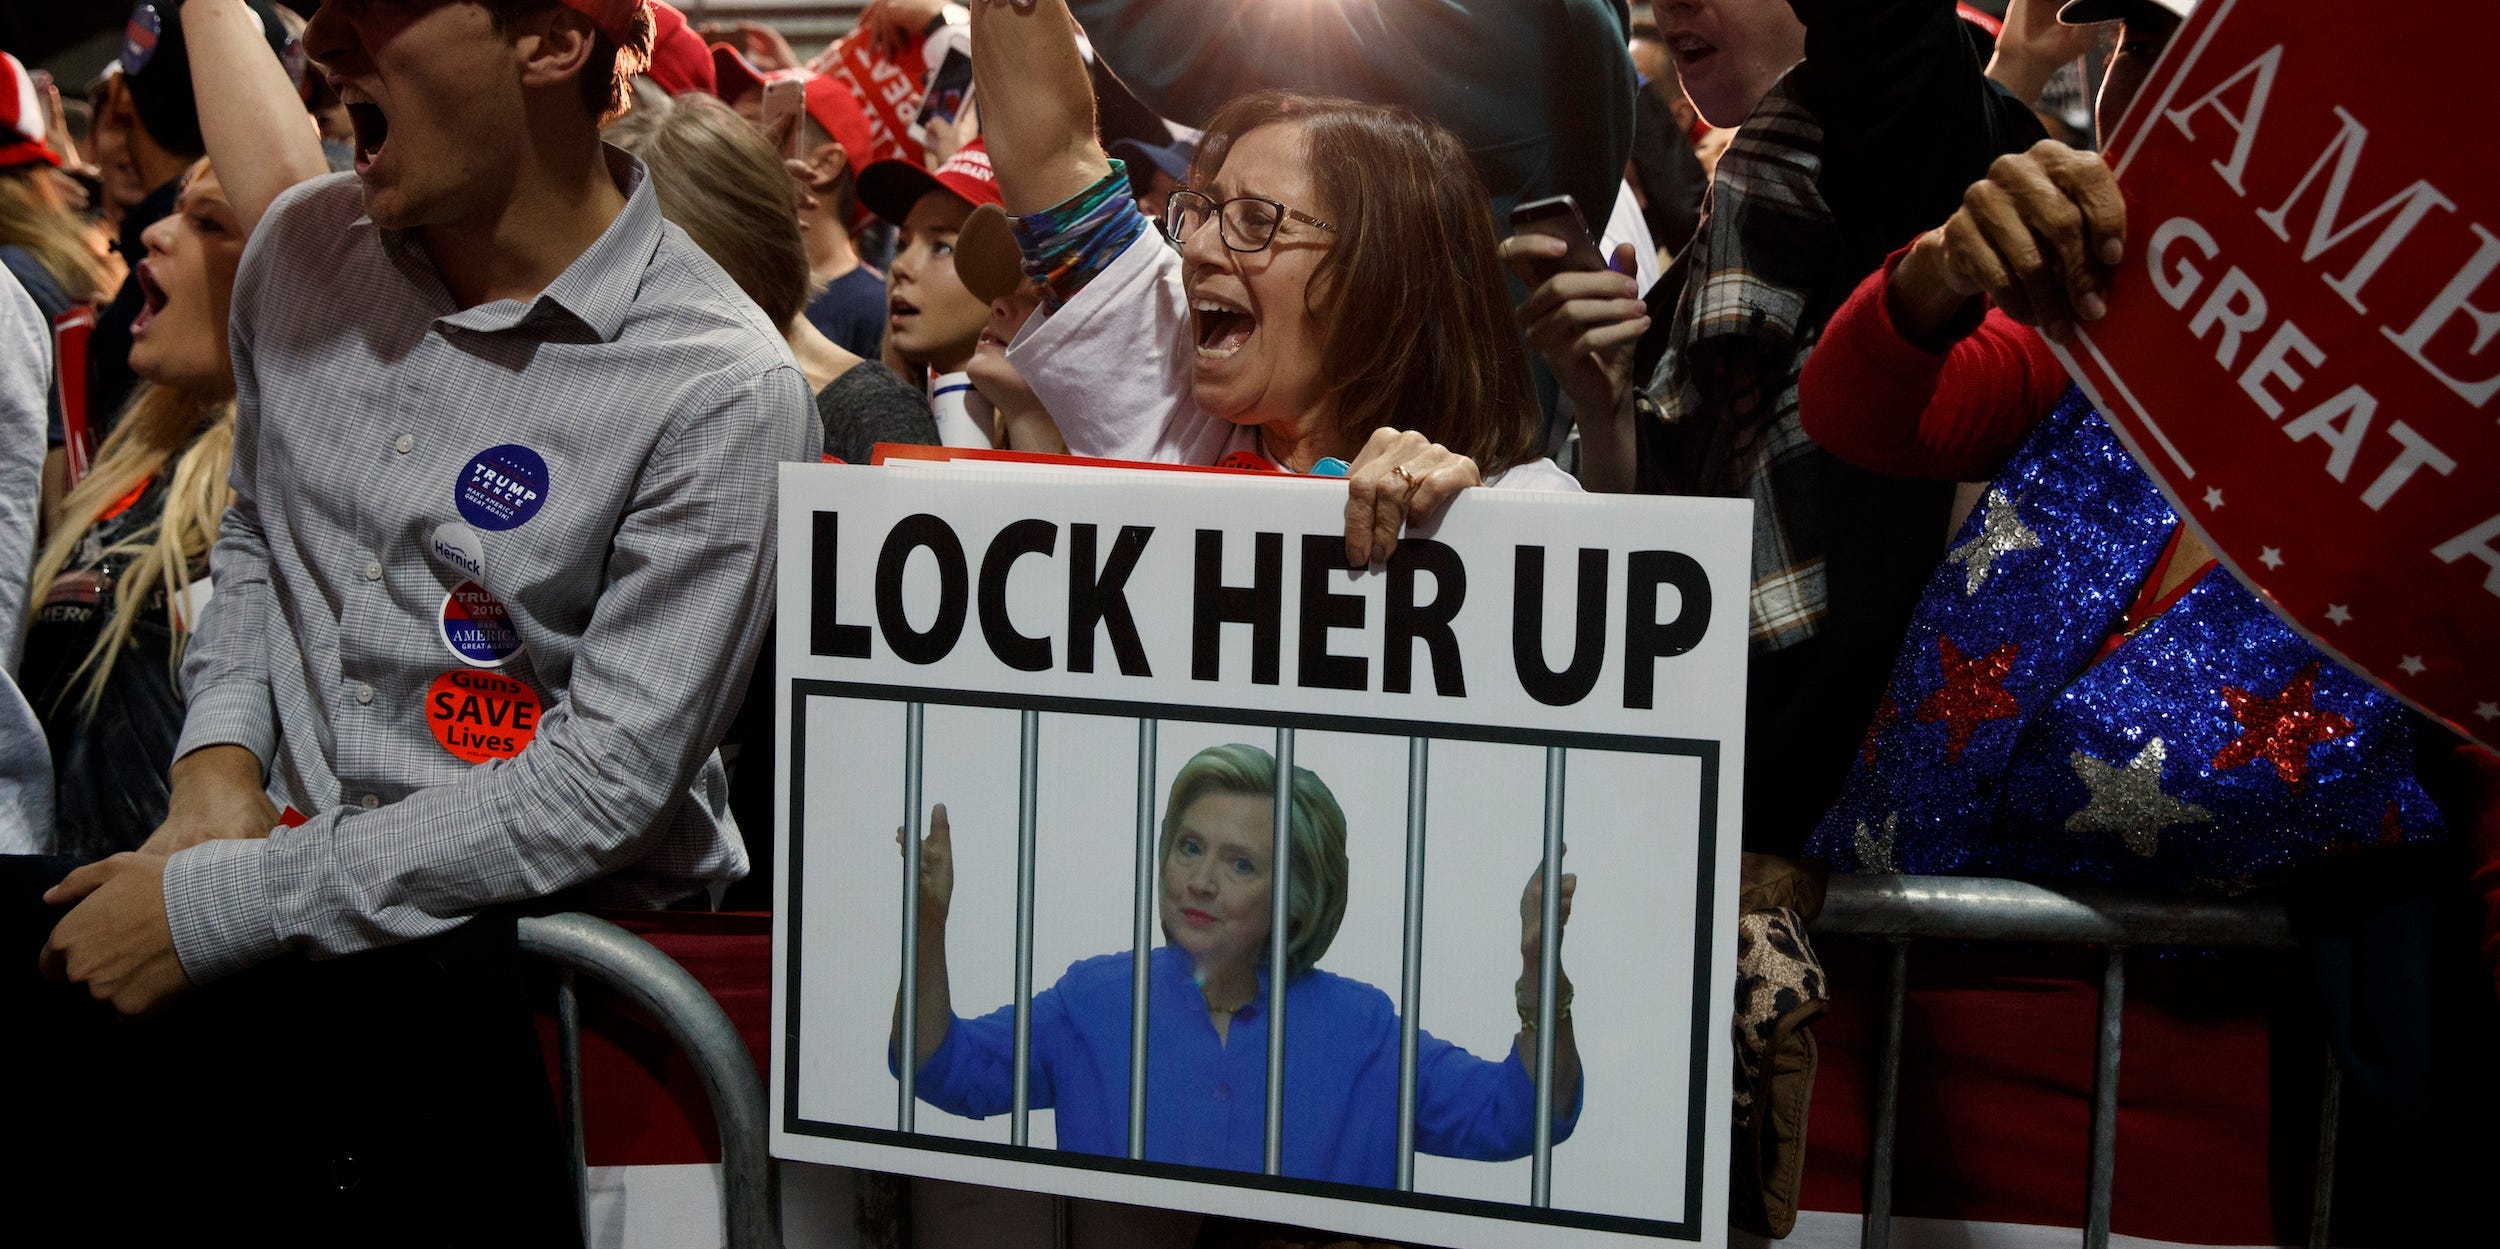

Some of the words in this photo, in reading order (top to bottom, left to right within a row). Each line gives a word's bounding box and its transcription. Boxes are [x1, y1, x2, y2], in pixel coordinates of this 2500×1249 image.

[2147, 216, 2457, 511] GREAT
[472, 476, 523, 507] PENCE
[474, 463, 537, 501] TRUMP
[465, 494, 485, 507] GREAT
[486, 503, 510, 521] AGAIN!
[466, 487, 486, 500] MAKE
[486, 497, 514, 516] AMERICA
[435, 540, 480, 576] Hernick
[472, 606, 503, 615] 2016
[809, 510, 1156, 678] LOCK
[1191, 528, 1468, 698] HER
[1512, 545, 1713, 711] UP
[451, 671, 521, 693] Guns
[433, 691, 534, 730] SAVE
[447, 725, 515, 752] Lives
